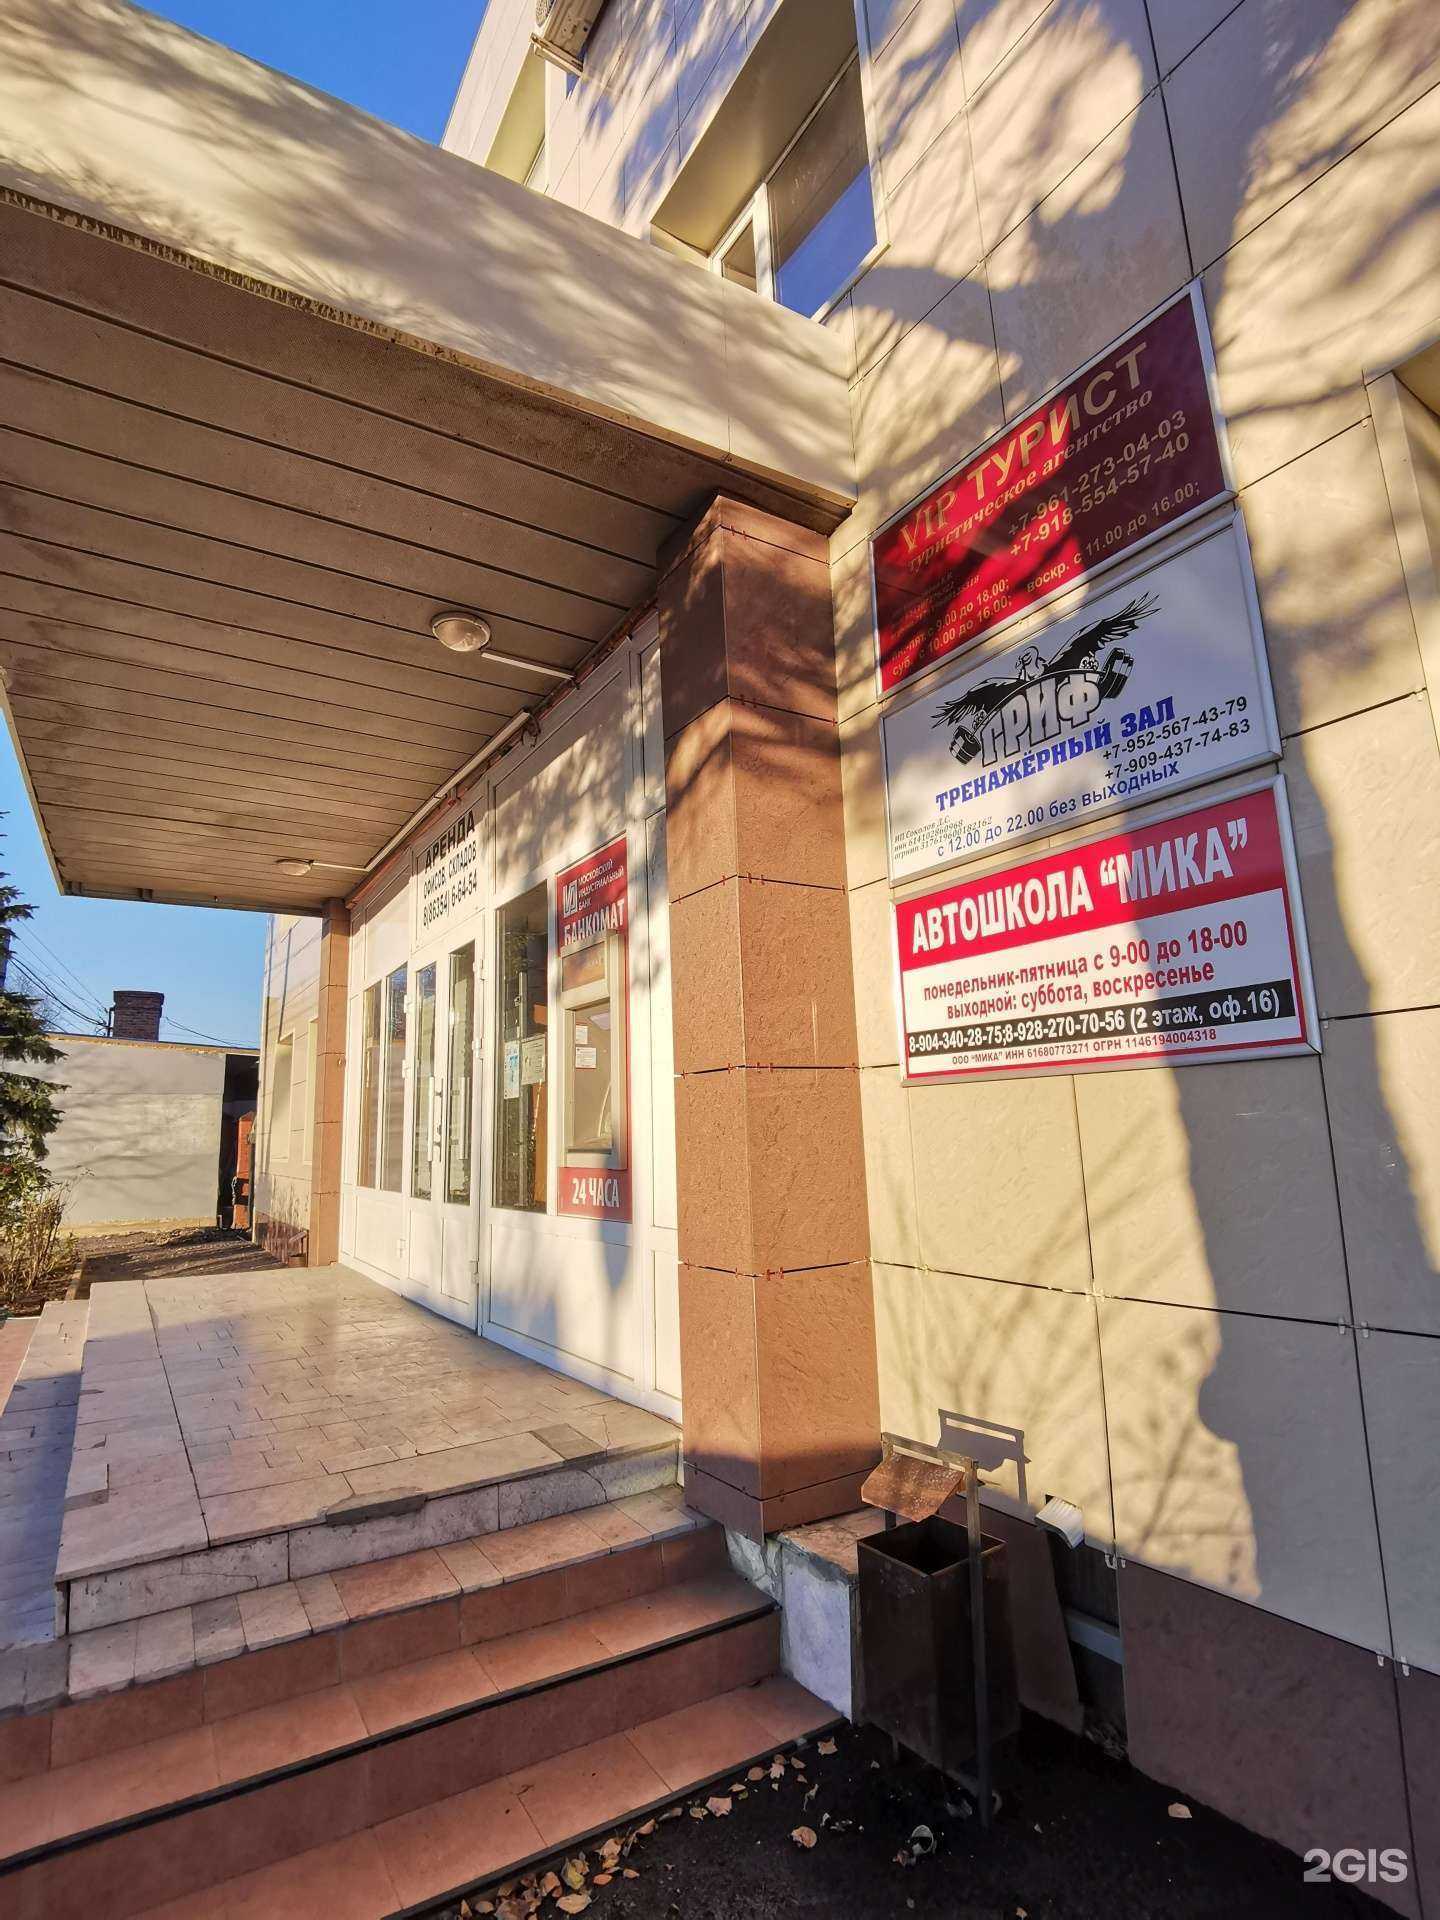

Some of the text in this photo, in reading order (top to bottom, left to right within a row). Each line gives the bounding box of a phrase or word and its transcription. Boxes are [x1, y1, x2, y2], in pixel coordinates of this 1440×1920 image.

[900, 342, 1147, 554] VIP ТУРИСТ
[909, 390, 1153, 574] туристическое агентство
[1008, 410, 1187, 537] +7-961-273-04-03
[1010, 433, 1190, 557] +7-918-554-57-40
[929, 629, 956, 652] 10.00
[959, 620, 974, 637] до
[1027, 562, 1070, 593] воскр.
[1074, 551, 1083, 564] с
[1086, 526, 1123, 557] 11.00
[1127, 513, 1147, 537] до
[1152, 480, 1200, 521] 16.00;
[960, 602, 973, 620] до
[935, 696, 1175, 812] ТРЕНАЖЁРНЫЙ ЗАЛ
[981, 673, 1102, 767] ГРИФ
[1103, 696, 1247, 760] +7-952-567-43-79
[1104, 720, 1251, 779] +7-909-437-74-83
[425, 810, 475, 874] АРЕНДА
[937, 762, 1180, 857] с 12.00 до 22.00 без выходных
[449, 840, 477, 879] СКЛАДОВ
[564, 898, 625, 946] БАНКОМАТ
[912, 865, 1094, 954] АВТОШКОЛА
[923, 920, 1248, 1001] понедельник-пятница с 9-00 до 18-00
[947, 960, 1215, 1020] выходной: суббота, воскресенье
[952, 1054, 969, 1065] ООО
[1005, 1048, 1025, 1060] ИНН
[1026, 1042, 1090, 1058] 61680773271
[1093, 1038, 1122, 1053] ОГРН
[1125, 1027, 1217, 1049] 1146194004318
[1130, 1006, 1148, 1035] (2
[1152, 1000, 1203, 1028] этаж,
[1209, 988, 1281, 1023] оф.16)
[572, 1178, 620, 1207] 24 ЧАСА
